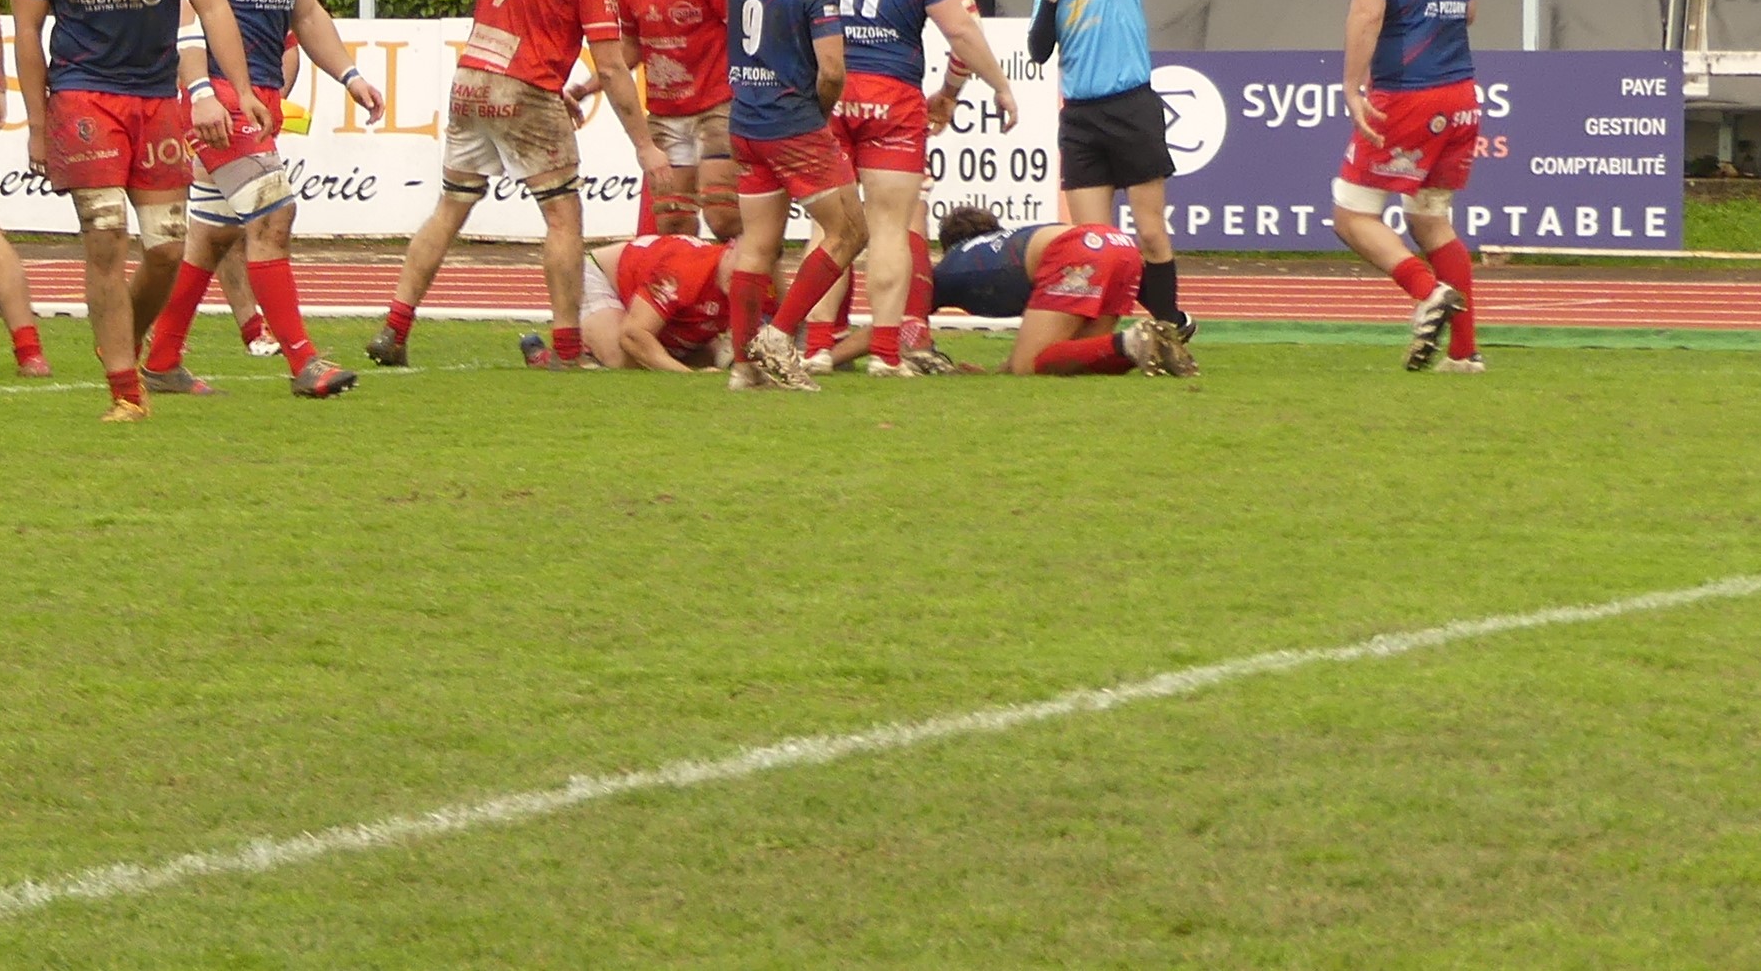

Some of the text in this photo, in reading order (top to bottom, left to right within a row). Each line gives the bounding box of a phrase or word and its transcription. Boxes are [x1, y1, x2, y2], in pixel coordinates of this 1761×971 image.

[1621, 78, 1667, 97] PAYE
[831, 101, 890, 120] SNTH
[1585, 117, 1667, 136] GESTION
[959, 148, 996, 182] 06
[1010, 148, 1048, 182] 09
[1530, 153, 1667, 176] COMPTABILITÉ
